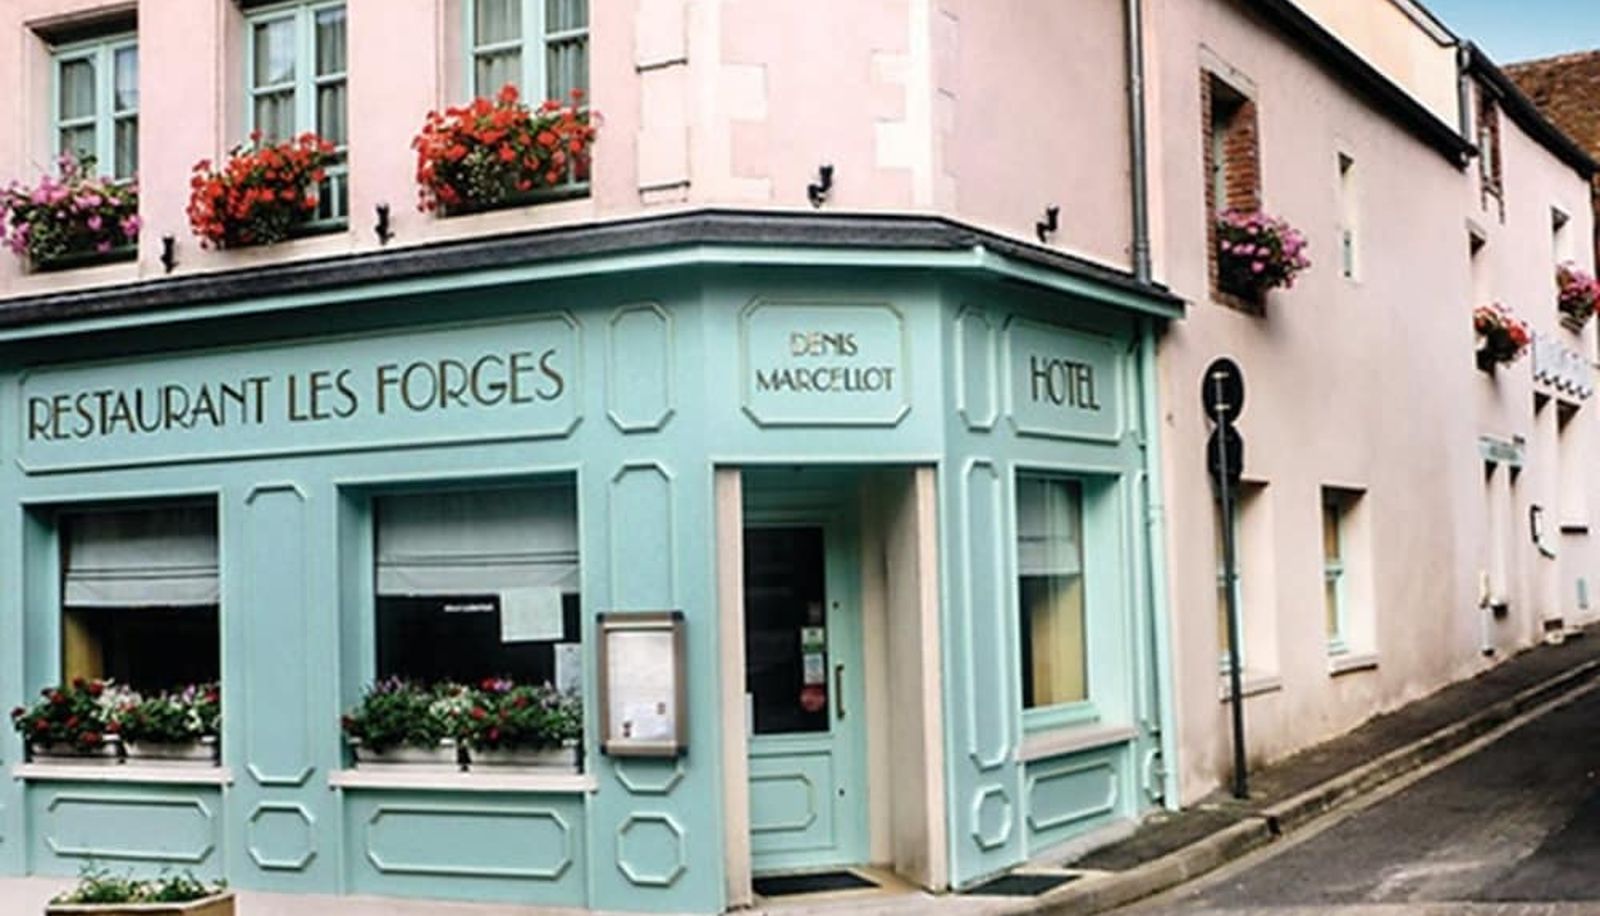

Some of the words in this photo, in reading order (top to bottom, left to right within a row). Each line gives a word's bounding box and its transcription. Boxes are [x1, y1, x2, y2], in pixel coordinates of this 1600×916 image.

[791, 333, 858, 357] DENIS
[28, 378, 271, 440] RESTAURANT
[288, 370, 359, 422] LES
[377, 350, 564, 414] FORGES
[756, 367, 895, 393] MARCELLOT
[1030, 356, 1101, 411] HOTEL
